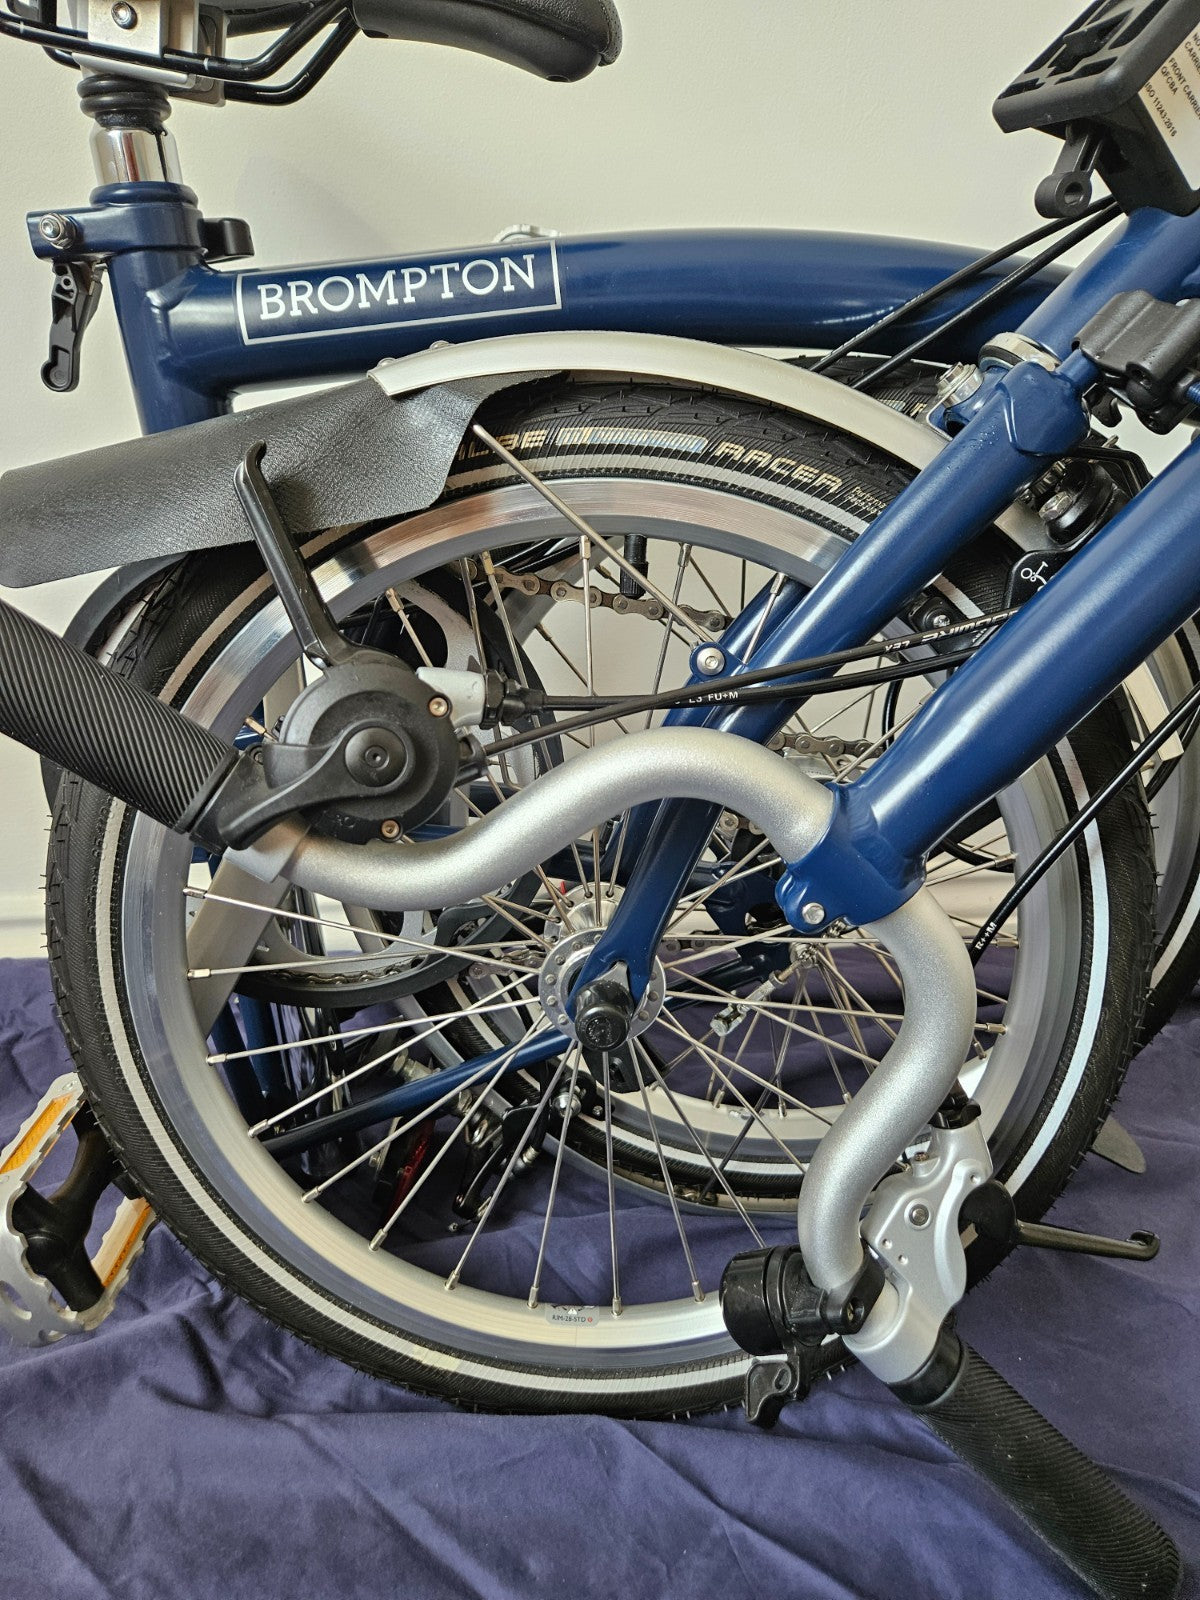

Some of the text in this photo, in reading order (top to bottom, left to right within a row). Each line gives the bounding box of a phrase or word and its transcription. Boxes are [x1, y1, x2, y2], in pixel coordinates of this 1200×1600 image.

[1169, 57, 1187, 86] FRONT
[1145, 82, 1178, 137] ISO 11243:2016
[257, 253, 535, 321] BROMPTON
[714, 441, 843, 494] RACER
[975, 921, 997, 950] R++M
